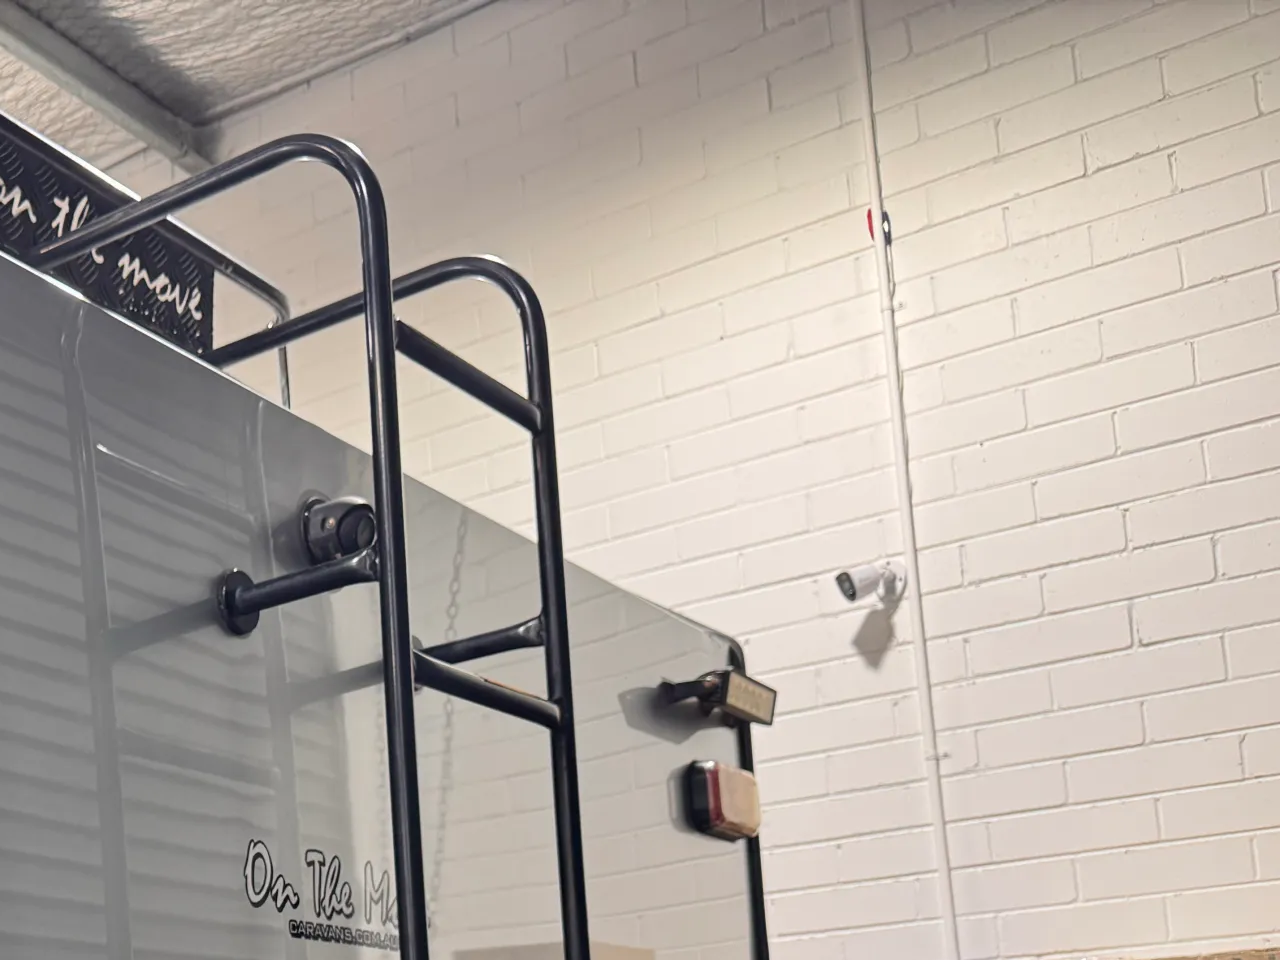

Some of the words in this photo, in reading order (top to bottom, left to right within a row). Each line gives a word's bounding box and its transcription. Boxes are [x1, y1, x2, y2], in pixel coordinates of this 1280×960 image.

[118, 253, 202, 320] move
[244, 839, 300, 913] On
[305, 849, 354, 921] The
